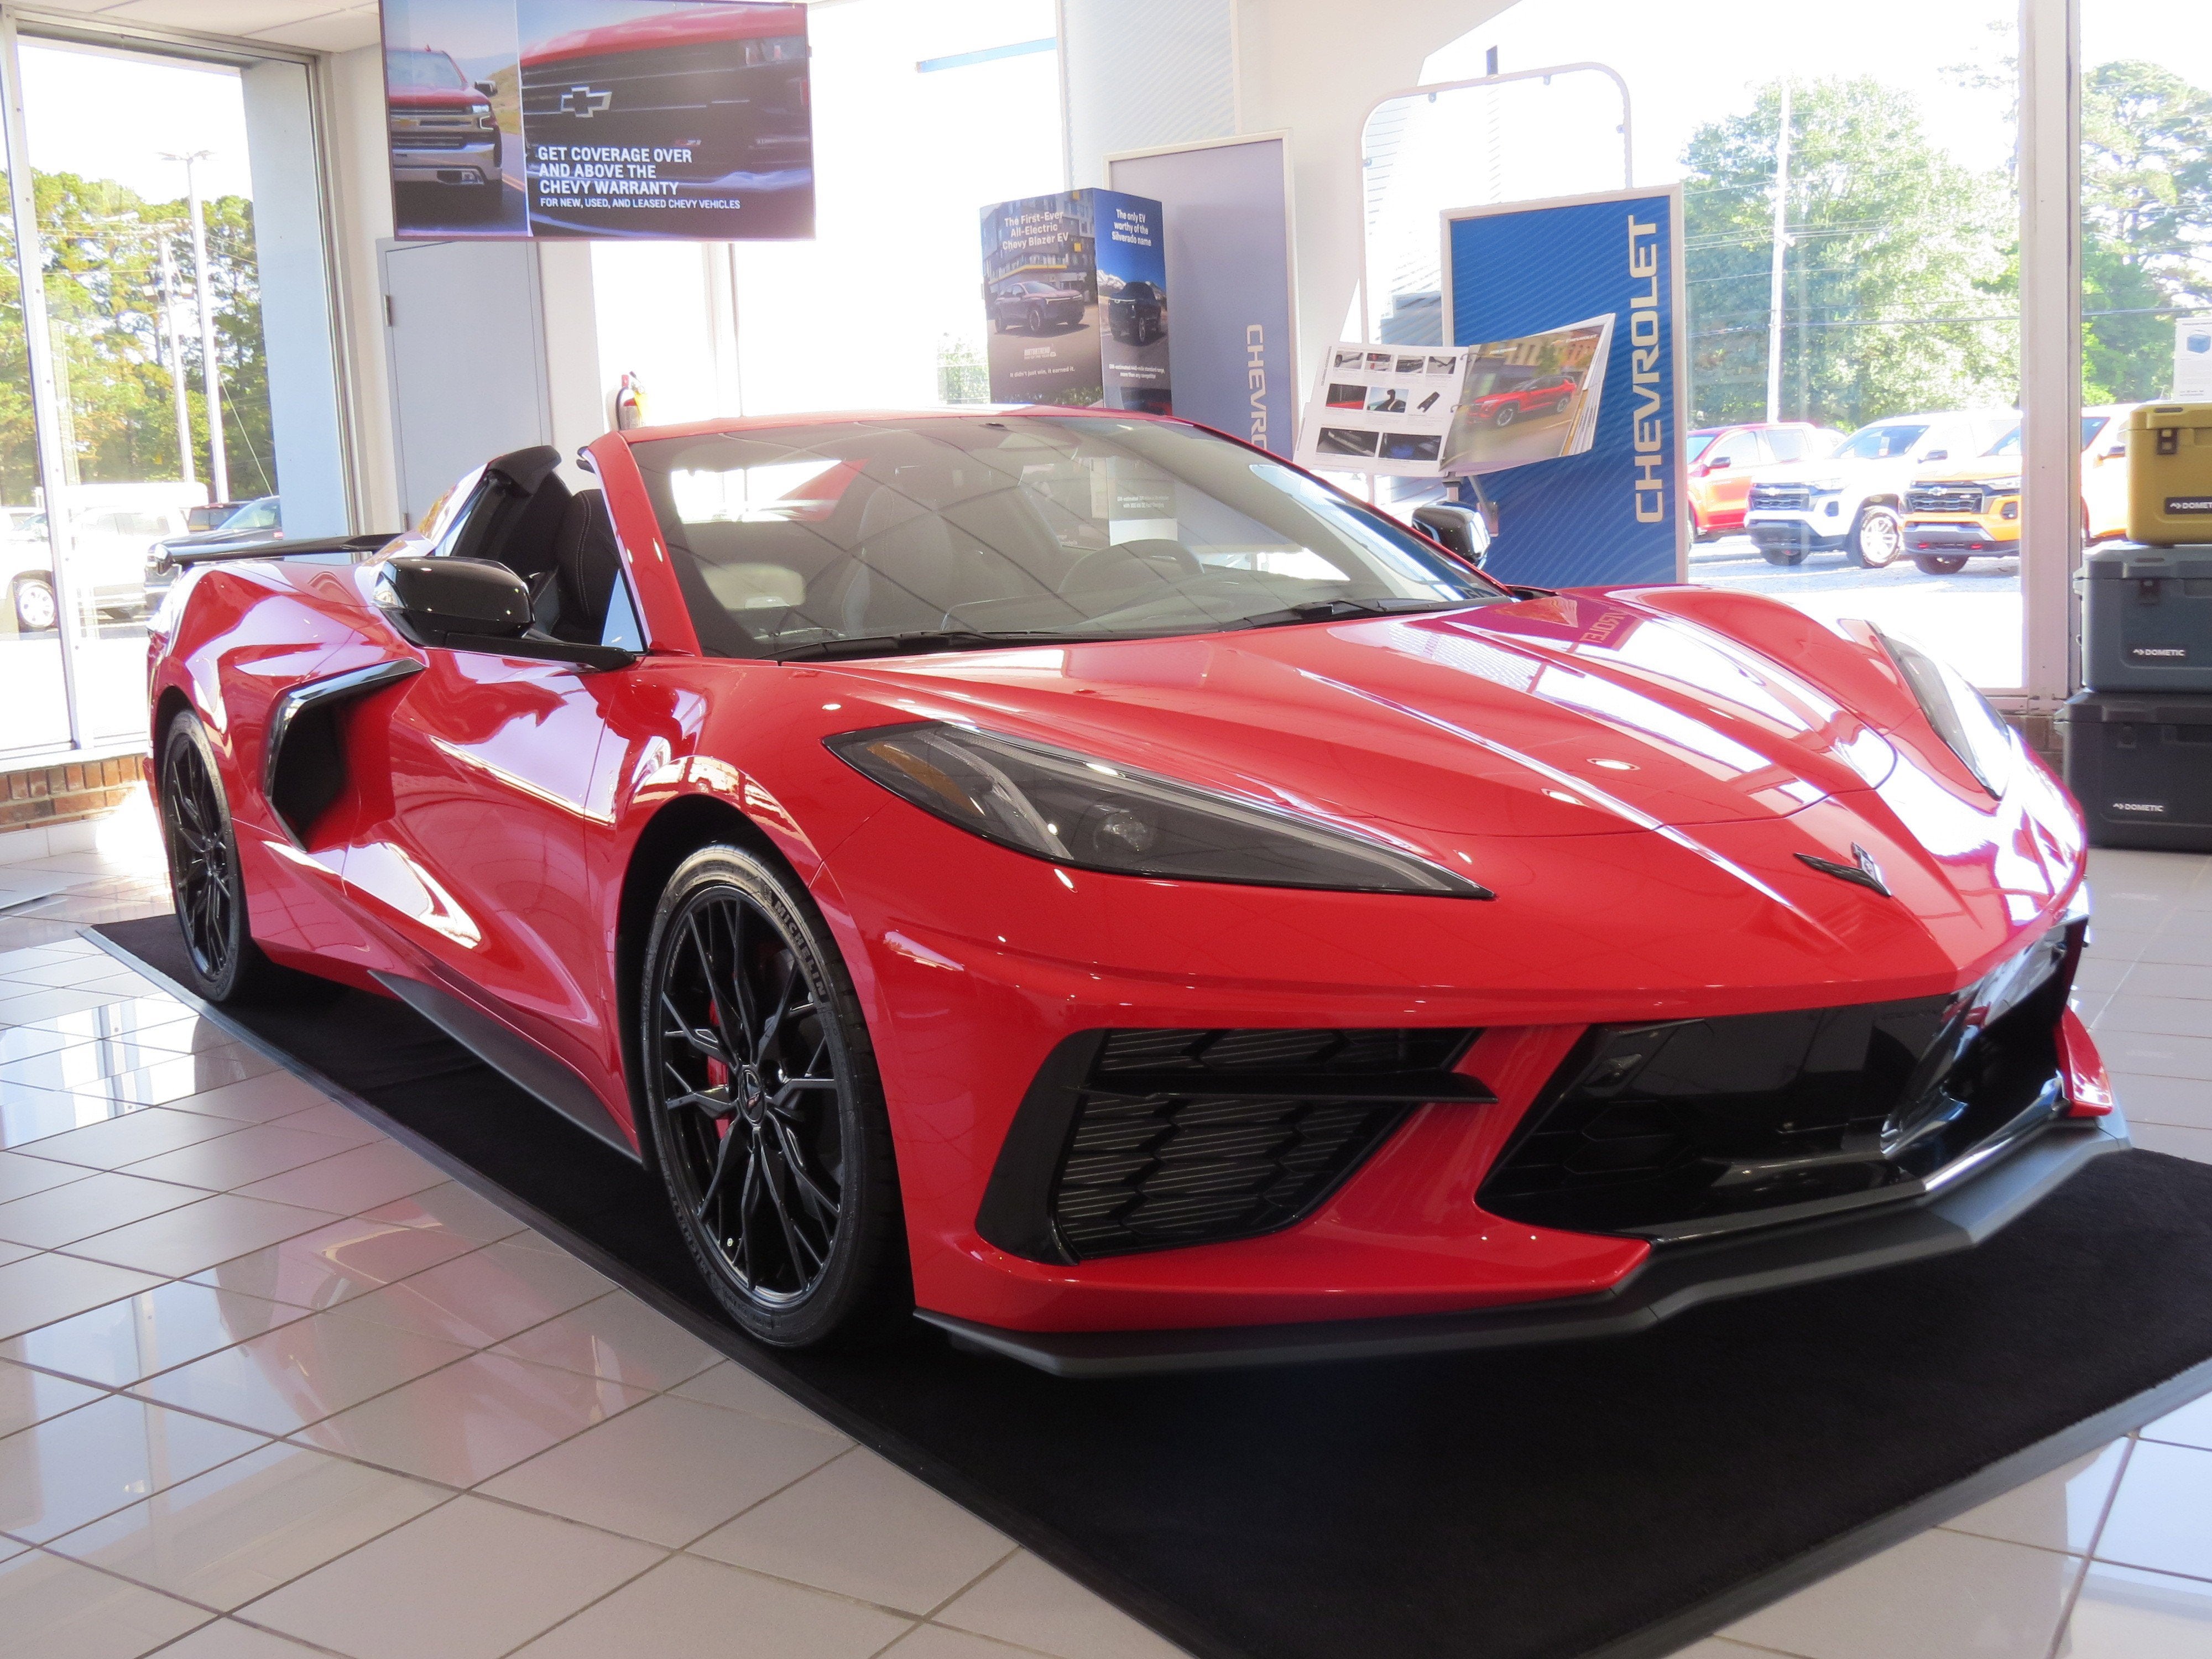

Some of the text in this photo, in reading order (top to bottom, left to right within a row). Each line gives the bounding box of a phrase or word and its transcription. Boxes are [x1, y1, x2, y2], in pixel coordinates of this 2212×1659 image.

[538, 147, 692, 163] GET COVERAGE OVER
[539, 163, 656, 179] AND ABOVE THE
[540, 179, 679, 195] CHEVY WARRANTY
[540, 197, 740, 209] FOR NEW, USED, AND LEASED CHEVY VEHICLES
[1004, 211, 1063, 227] The First-Ever
[1116, 208, 1146, 223] The only EV
[1011, 222, 1058, 237] All-Electric
[1114, 222, 1149, 235] worthy of the
[1002, 232, 1069, 251] Chevy Blazer EV
[1112, 231, 1151, 247] Silverado name
[1628, 215, 1663, 523] CHEVROLET
[2125, 804, 2163, 812] DOMETIC
[775, 901, 826, 995] MICHELIN
